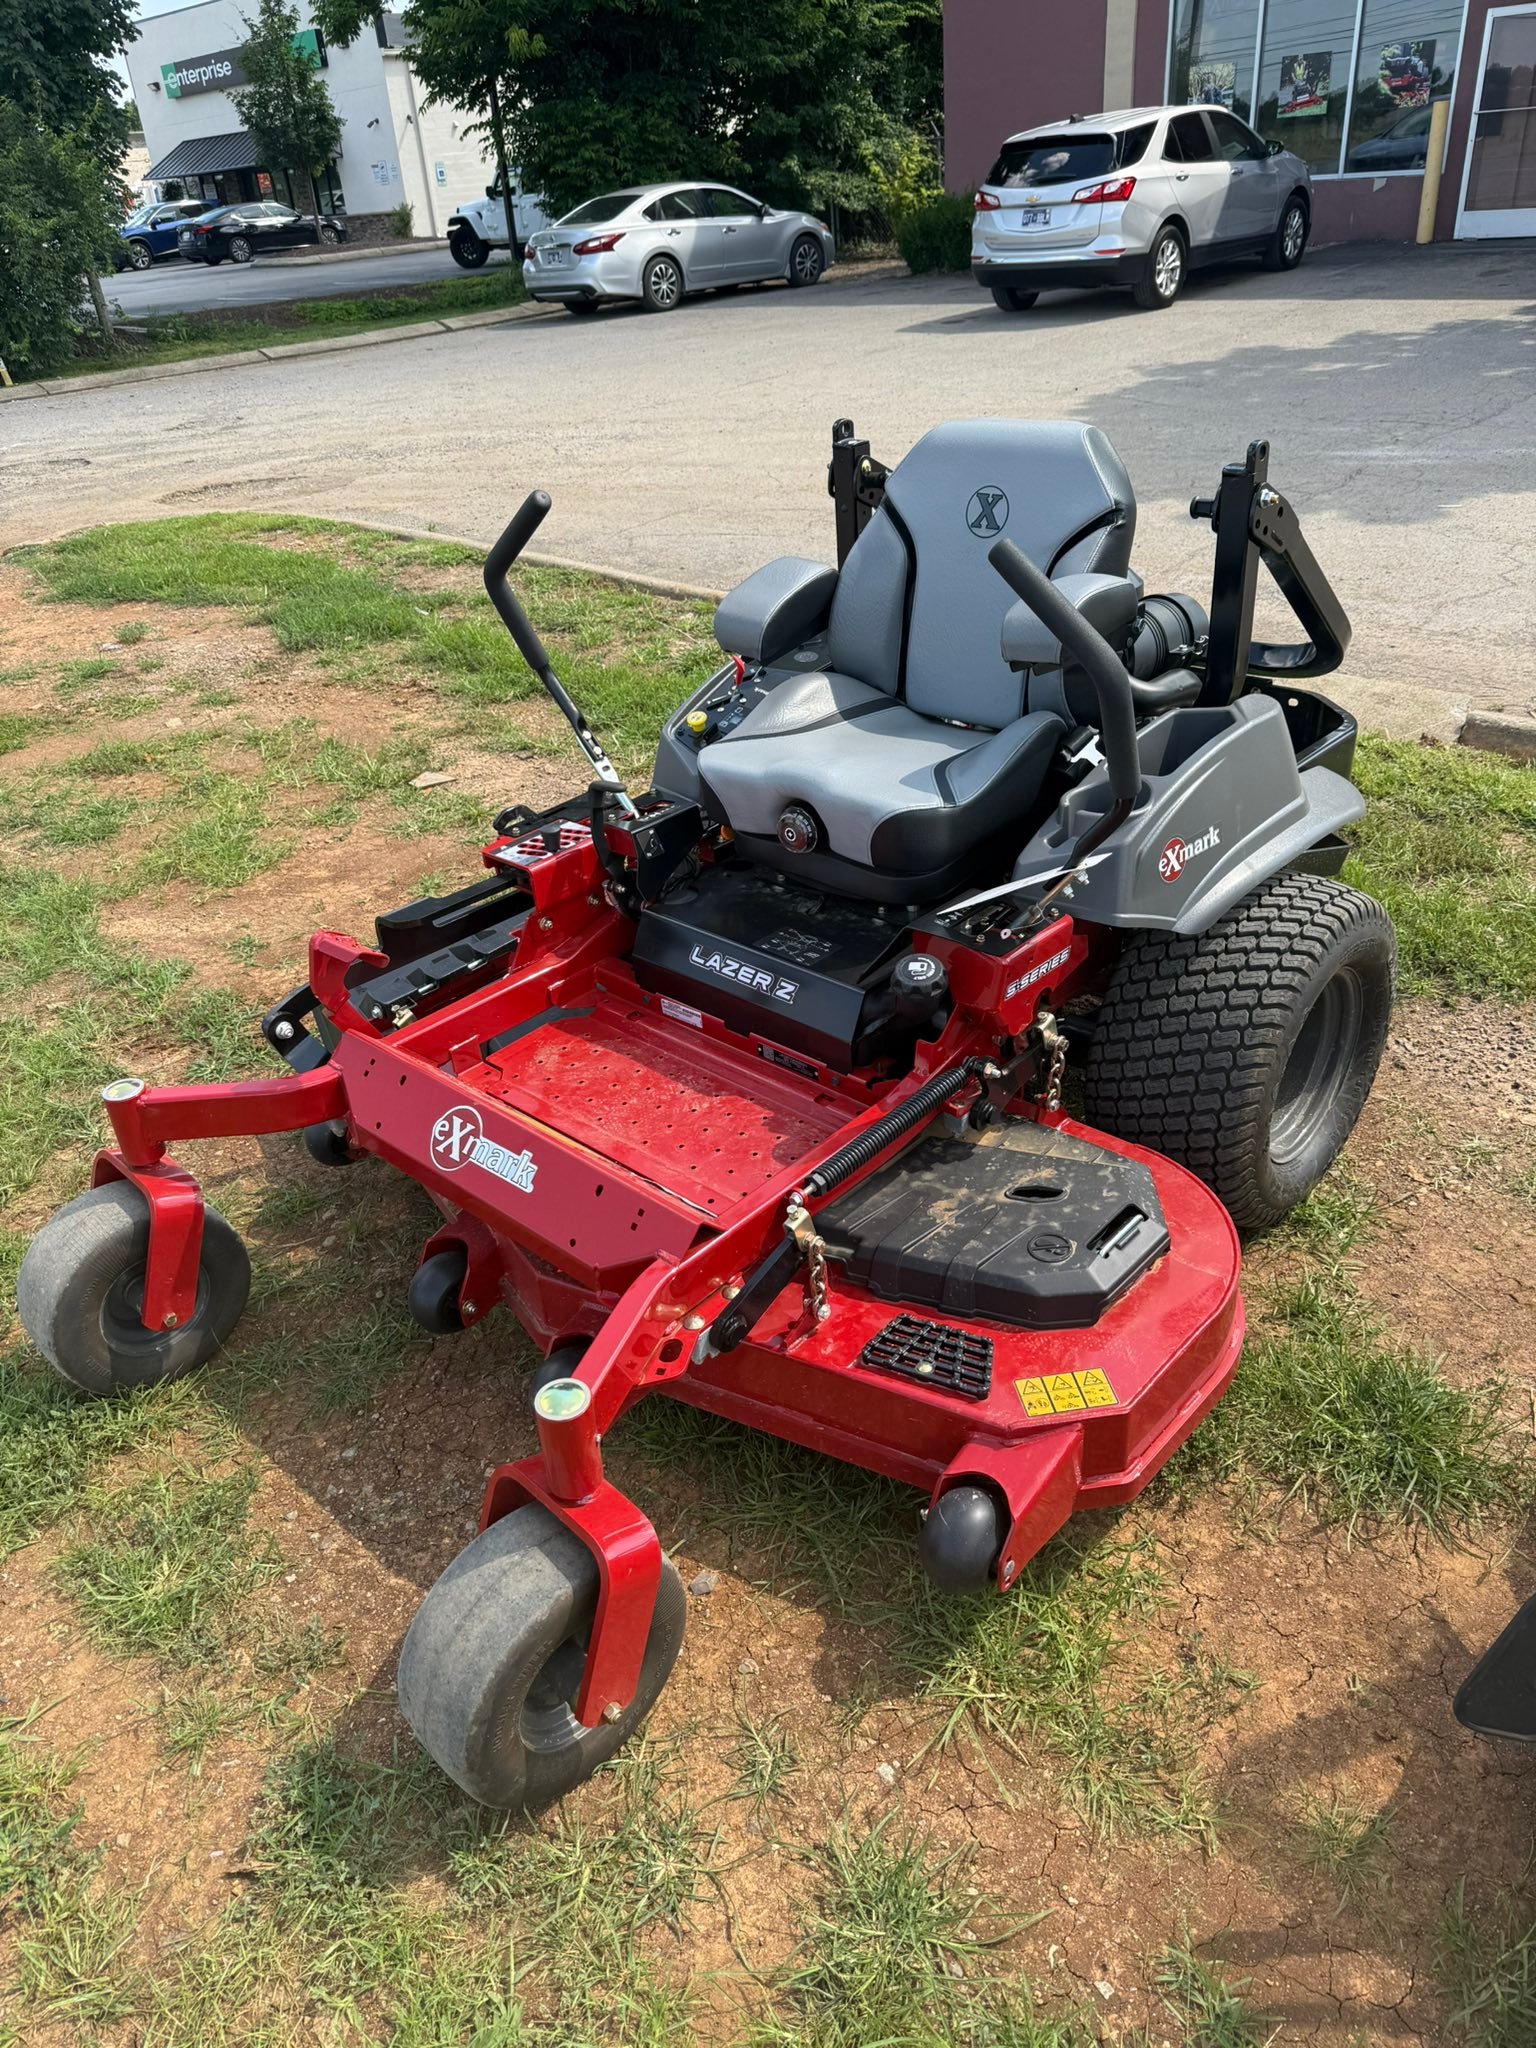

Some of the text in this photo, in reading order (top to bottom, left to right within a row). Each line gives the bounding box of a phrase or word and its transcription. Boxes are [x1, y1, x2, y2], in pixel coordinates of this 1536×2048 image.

[167, 59, 232, 89] enterprise
[970, 492, 1004, 531] X
[689, 944, 775, 996] LAZER
[772, 977, 799, 1004] Z
